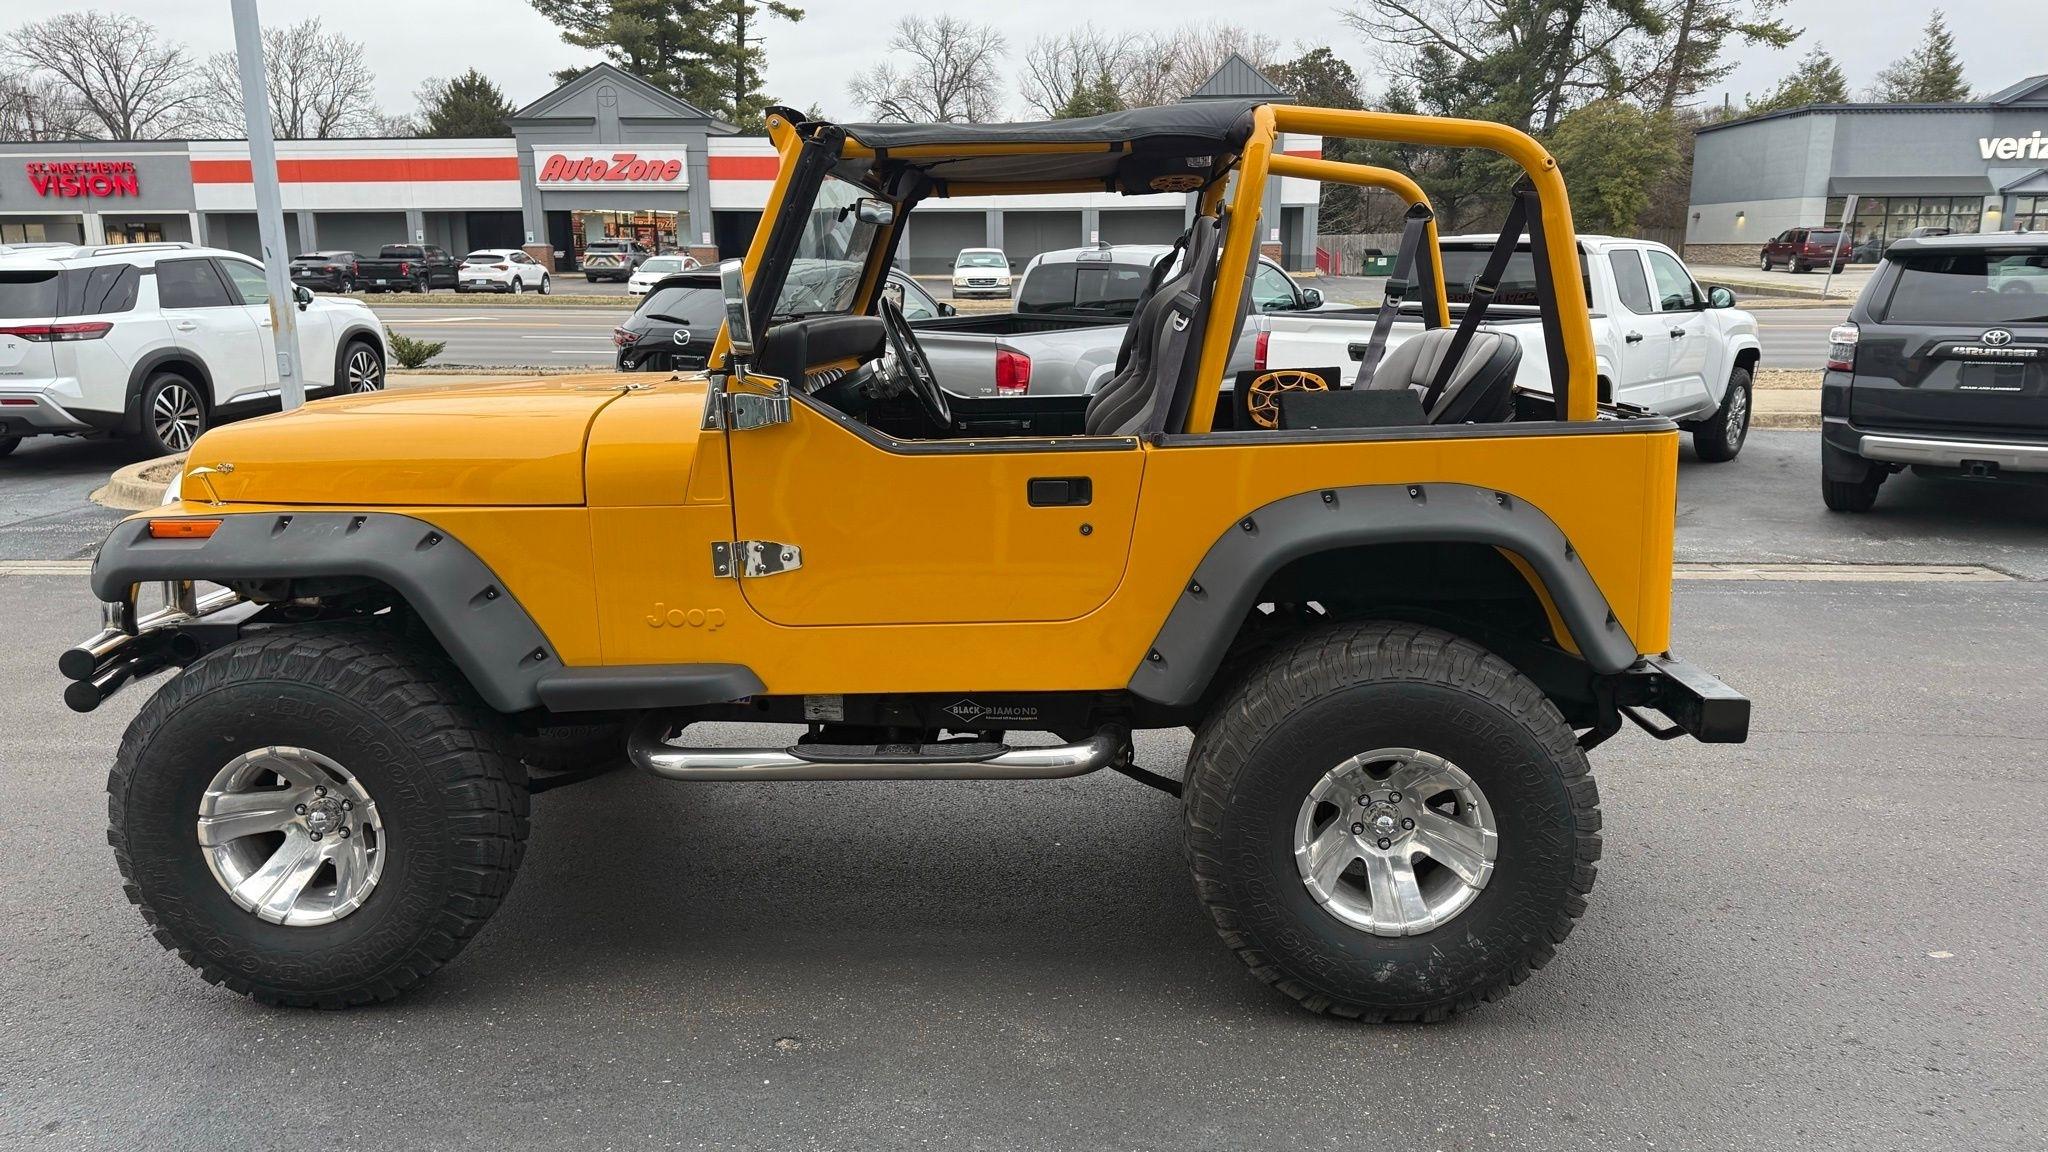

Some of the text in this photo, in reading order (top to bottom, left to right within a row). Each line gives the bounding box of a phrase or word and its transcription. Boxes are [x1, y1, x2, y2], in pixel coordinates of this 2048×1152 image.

[48, 161, 137, 175] MATTHEWS
[539, 154, 682, 181] AutoZone
[28, 175, 139, 197] VISION
[953, 705, 1039, 716] BLACK DIAMOND
